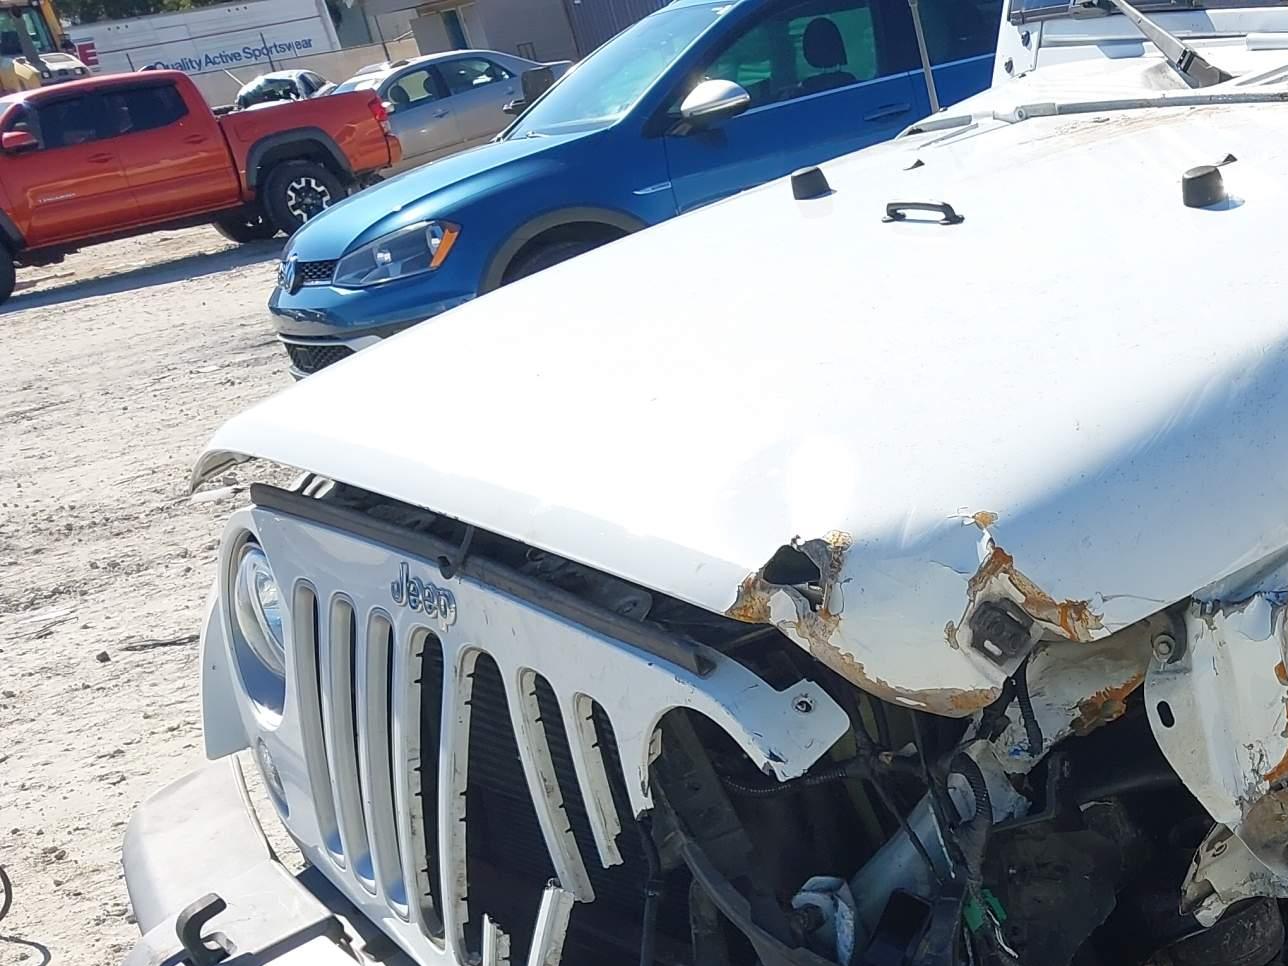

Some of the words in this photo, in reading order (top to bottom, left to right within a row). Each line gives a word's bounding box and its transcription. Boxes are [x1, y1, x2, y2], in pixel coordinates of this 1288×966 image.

[203, 51, 243, 67] Active
[242, 38, 313, 60] Sportswear
[391, 560, 458, 633] Jeep
